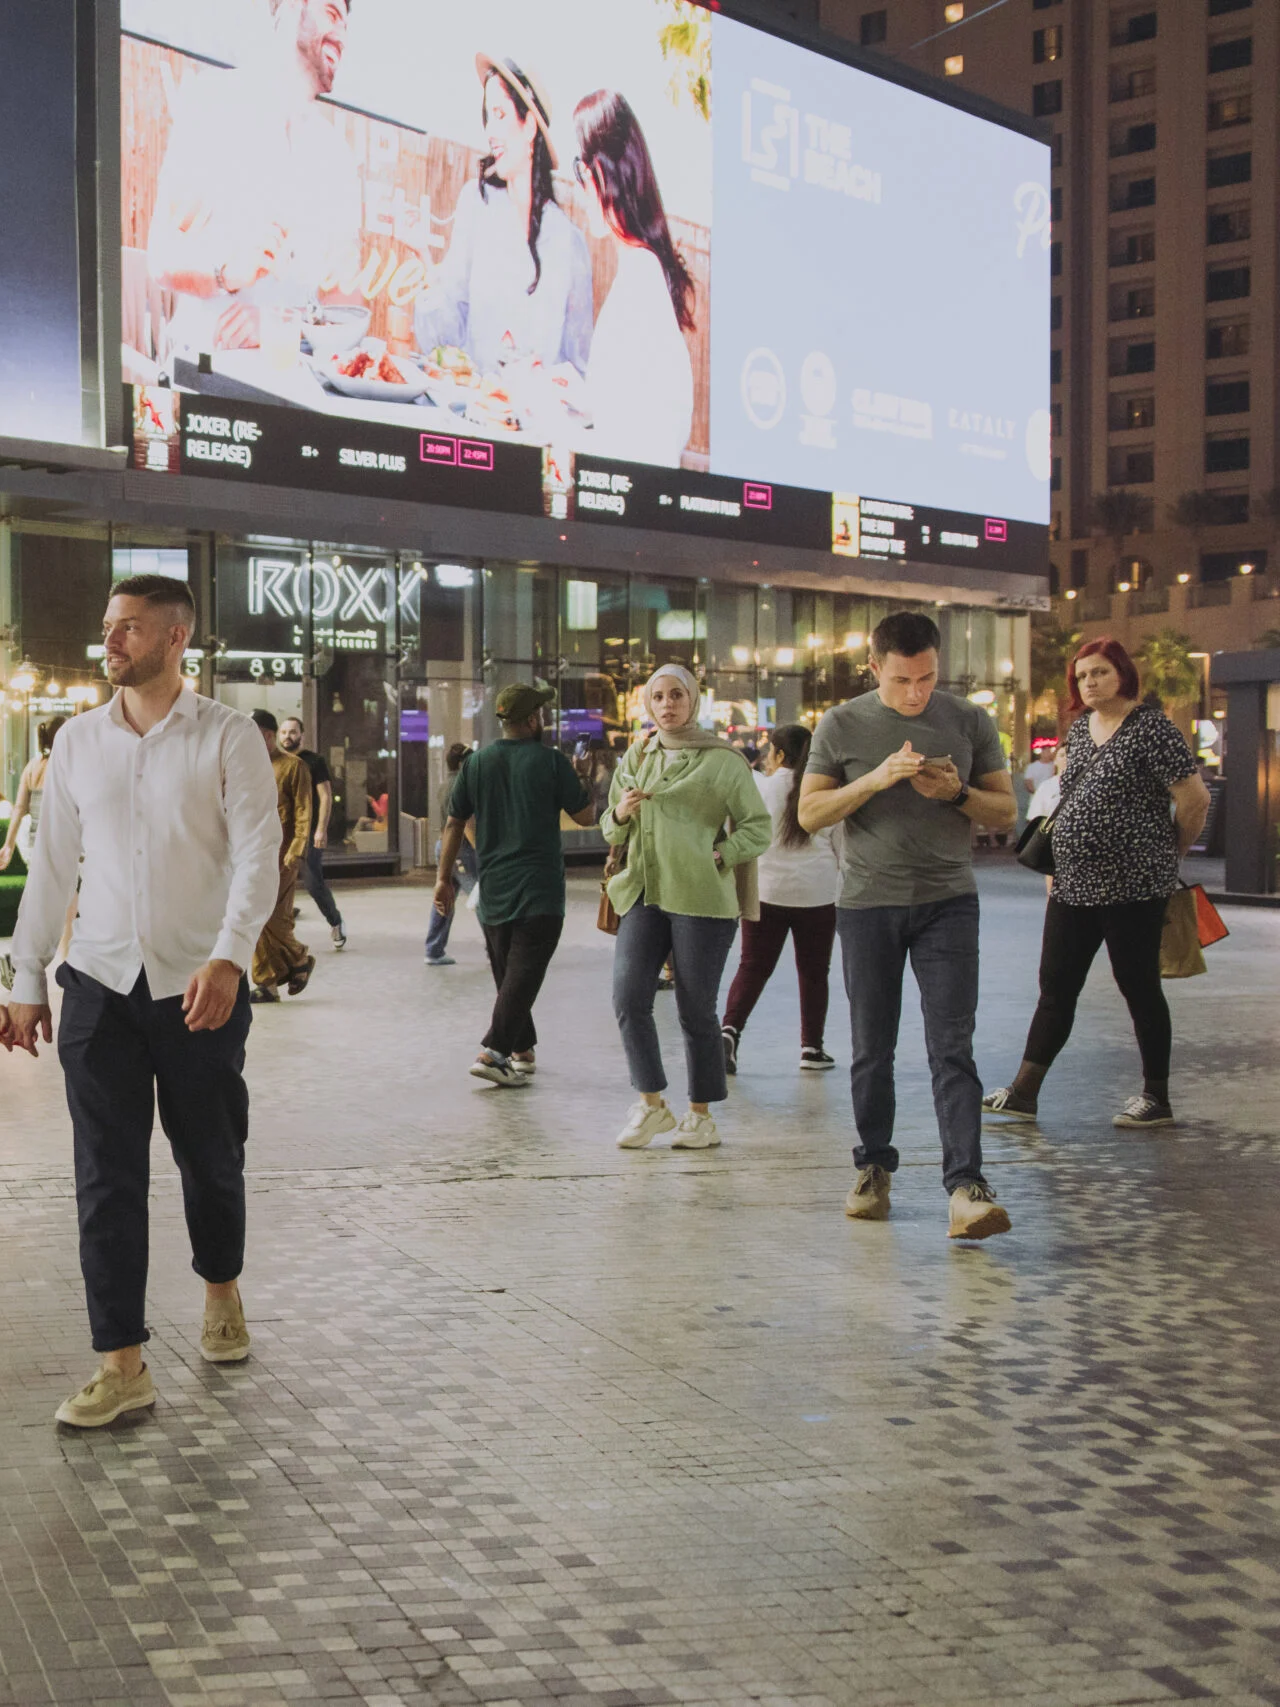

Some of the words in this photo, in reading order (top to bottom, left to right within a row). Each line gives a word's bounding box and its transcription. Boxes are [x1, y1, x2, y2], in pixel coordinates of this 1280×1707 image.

[804, 112, 851, 162] THE
[804, 148, 883, 204] BEACH
[186, 413, 230, 438] JOKER
[232, 420, 262, 442] (RE-
[186, 438, 251, 468] RELEASE)
[339, 447, 378, 469] SILVER
[379, 452, 406, 472] PLUS
[186, 658, 200, 677] 5
[250, 658, 264, 677] 8
[271, 658, 286, 677] 9
